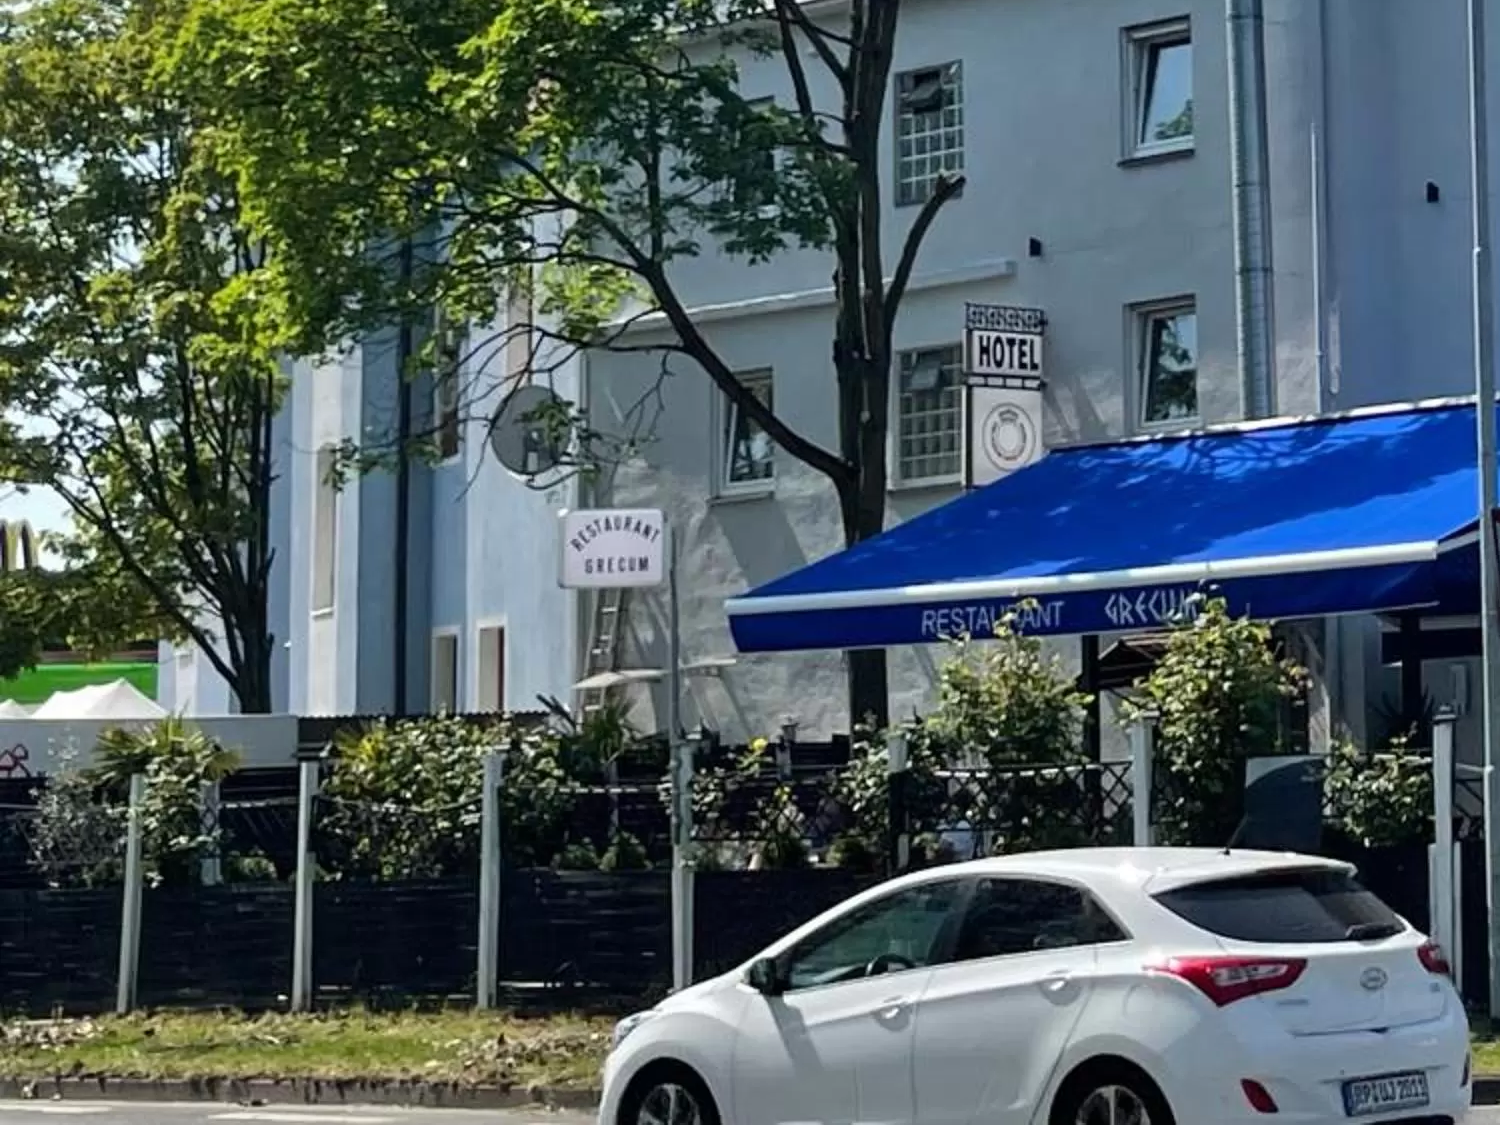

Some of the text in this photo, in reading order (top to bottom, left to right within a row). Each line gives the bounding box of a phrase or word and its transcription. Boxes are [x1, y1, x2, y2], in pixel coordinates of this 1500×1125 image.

[978, 334, 1040, 372] HOTEL
[570, 515, 661, 552] RESTAURANT
[585, 556, 649, 574] GRECUM
